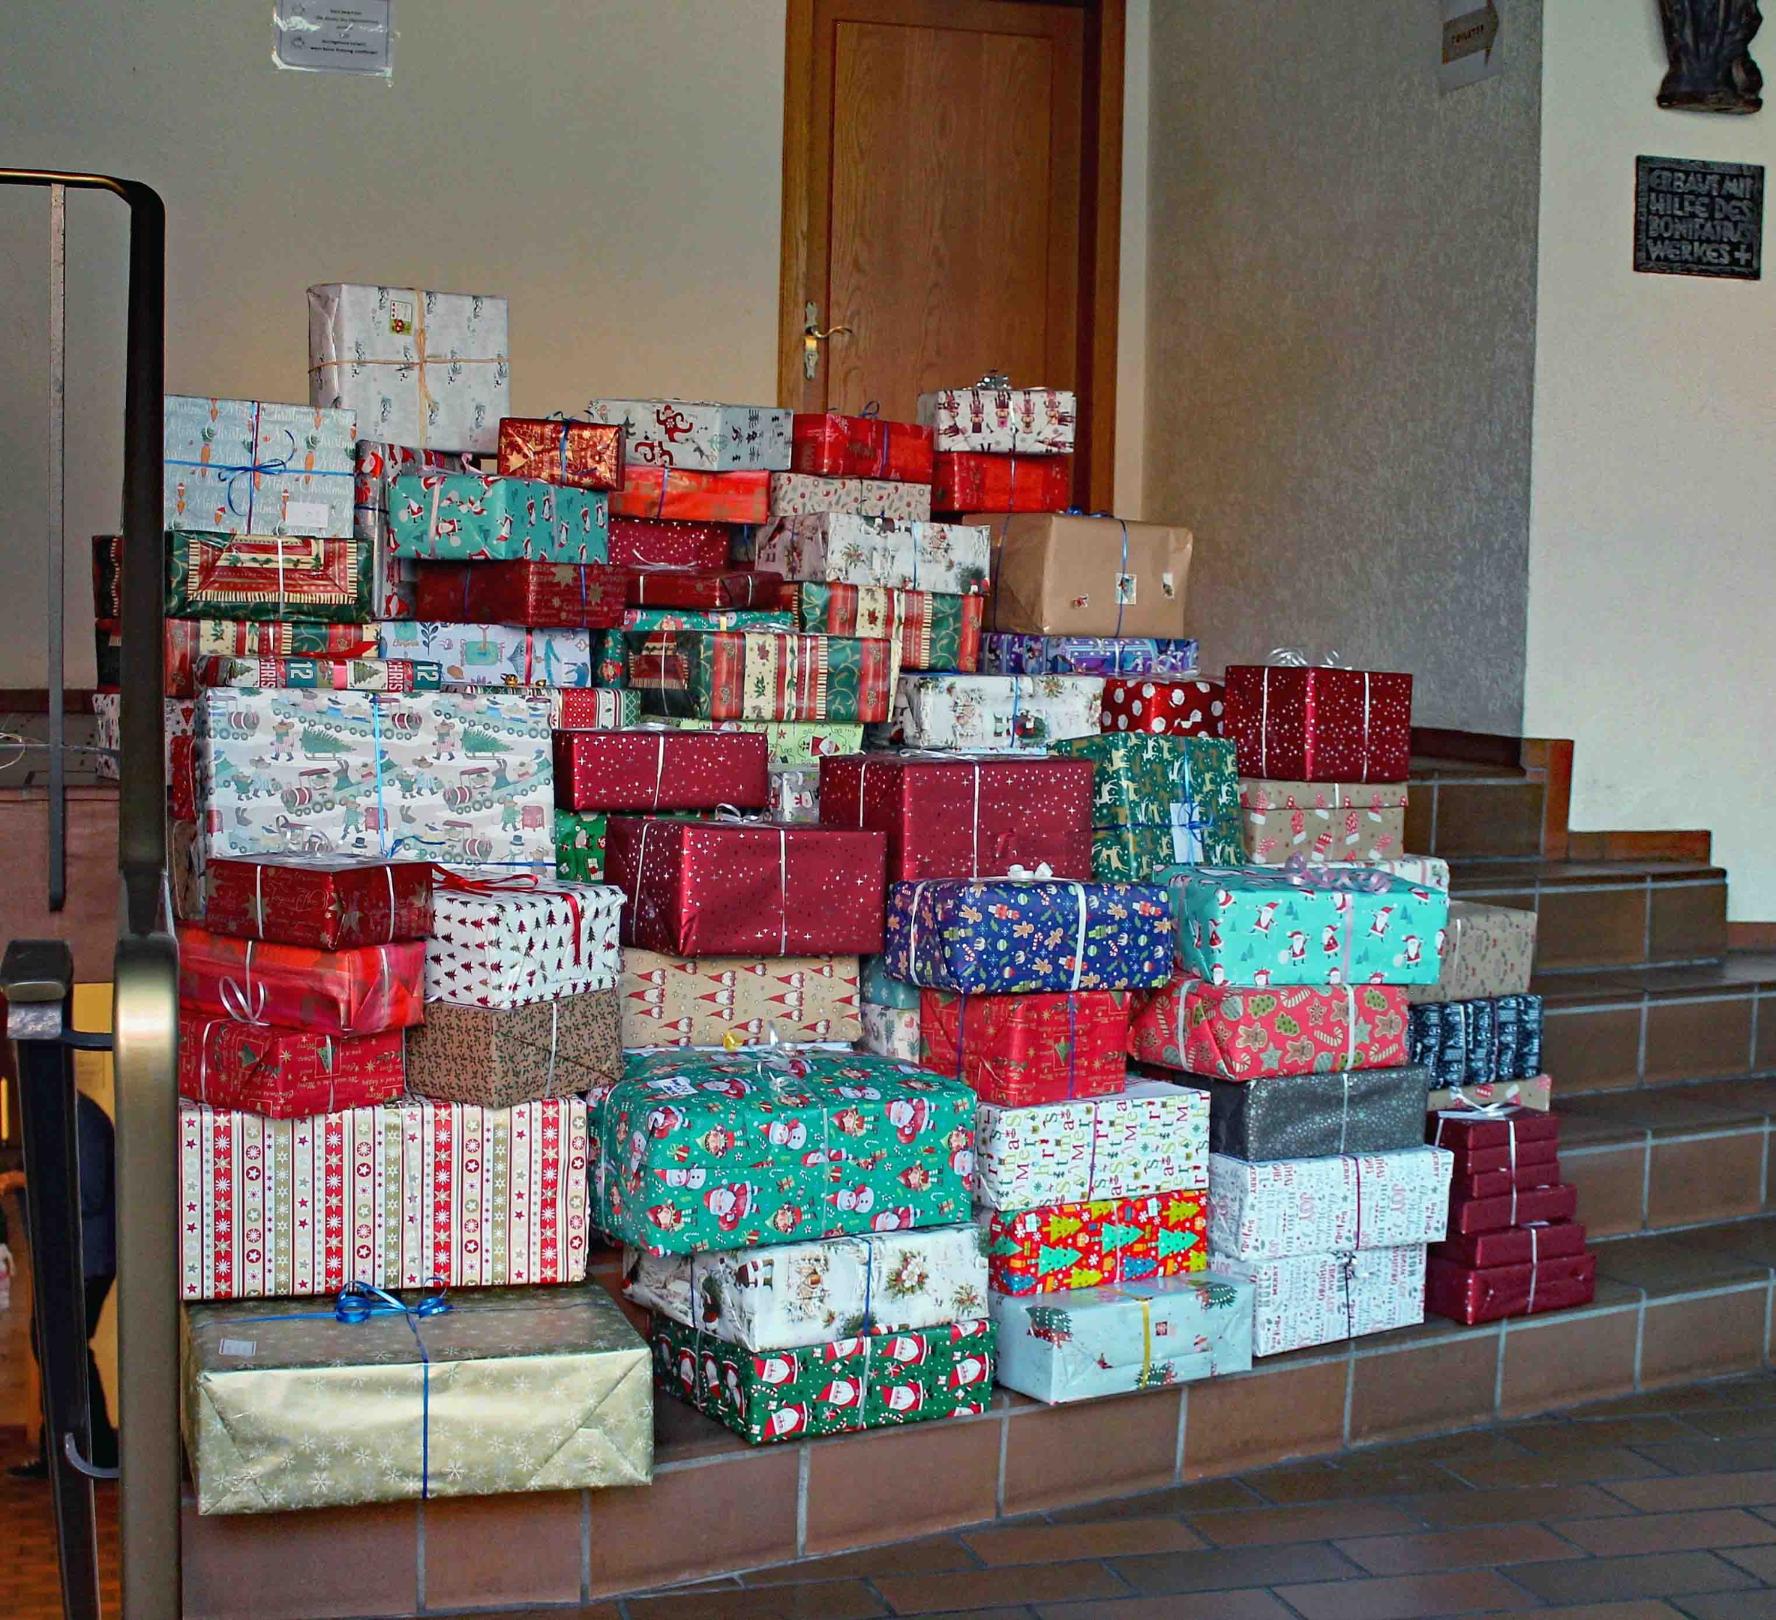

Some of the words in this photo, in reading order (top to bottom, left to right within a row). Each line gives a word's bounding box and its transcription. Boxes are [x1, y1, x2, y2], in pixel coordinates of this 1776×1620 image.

[1721, 175, 1754, 198] MIT
[1649, 192, 1709, 218] HILFE
[1647, 238, 1731, 264] WERKES
[289, 662, 313, 679] 12
[388, 660, 404, 692] HRIS
[416, 663, 439, 681] 12
